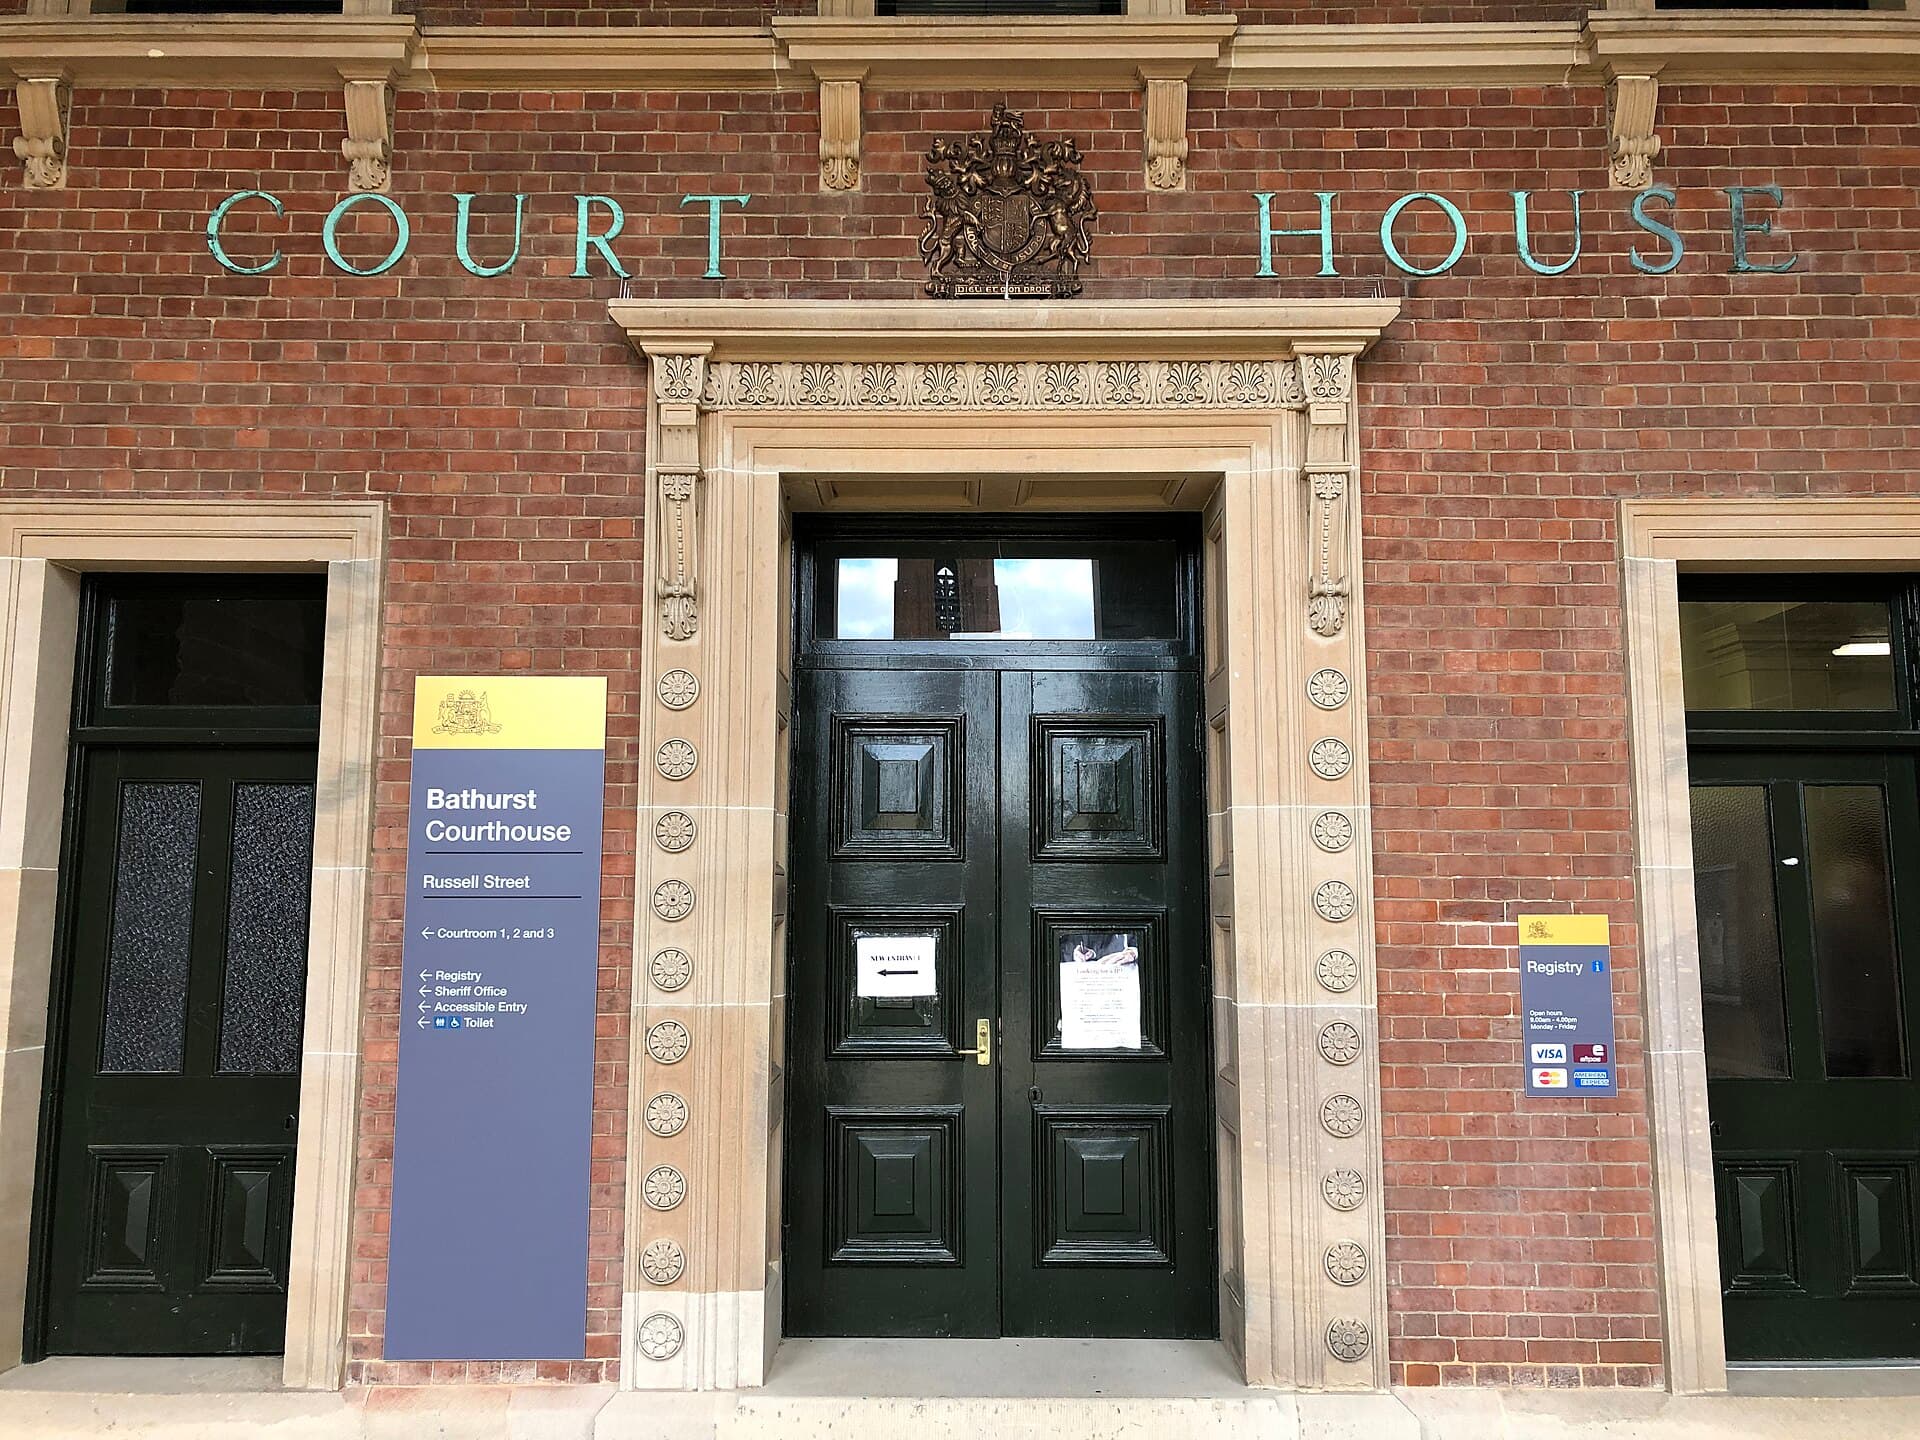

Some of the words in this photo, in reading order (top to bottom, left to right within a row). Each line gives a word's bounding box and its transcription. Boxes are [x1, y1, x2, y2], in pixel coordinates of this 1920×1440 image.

[206, 189, 752, 279] COURT
[1252, 186, 1799, 278] HOUSE
[426, 788, 537, 810] Bathurst
[425, 819, 572, 842] Courthouse
[423, 874, 479, 889] Russell
[483, 874, 530, 889] Street
[437, 928, 497, 939] Courtroom
[500, 928, 510, 940] 1,
[513, 928, 521, 939] 2
[523, 928, 544, 939] and
[547, 928, 555, 939] 3
[1527, 960, 1583, 976] Registry
[435, 970, 482, 983] Registry
[434, 985, 471, 997] Sheriff
[474, 985, 507, 997] Office
[434, 1001, 496, 1012] Accessible
[498, 1001, 528, 1015] Entry
[464, 1017, 494, 1028] Toilet
[1536, 1049, 1563, 1059] VISA
